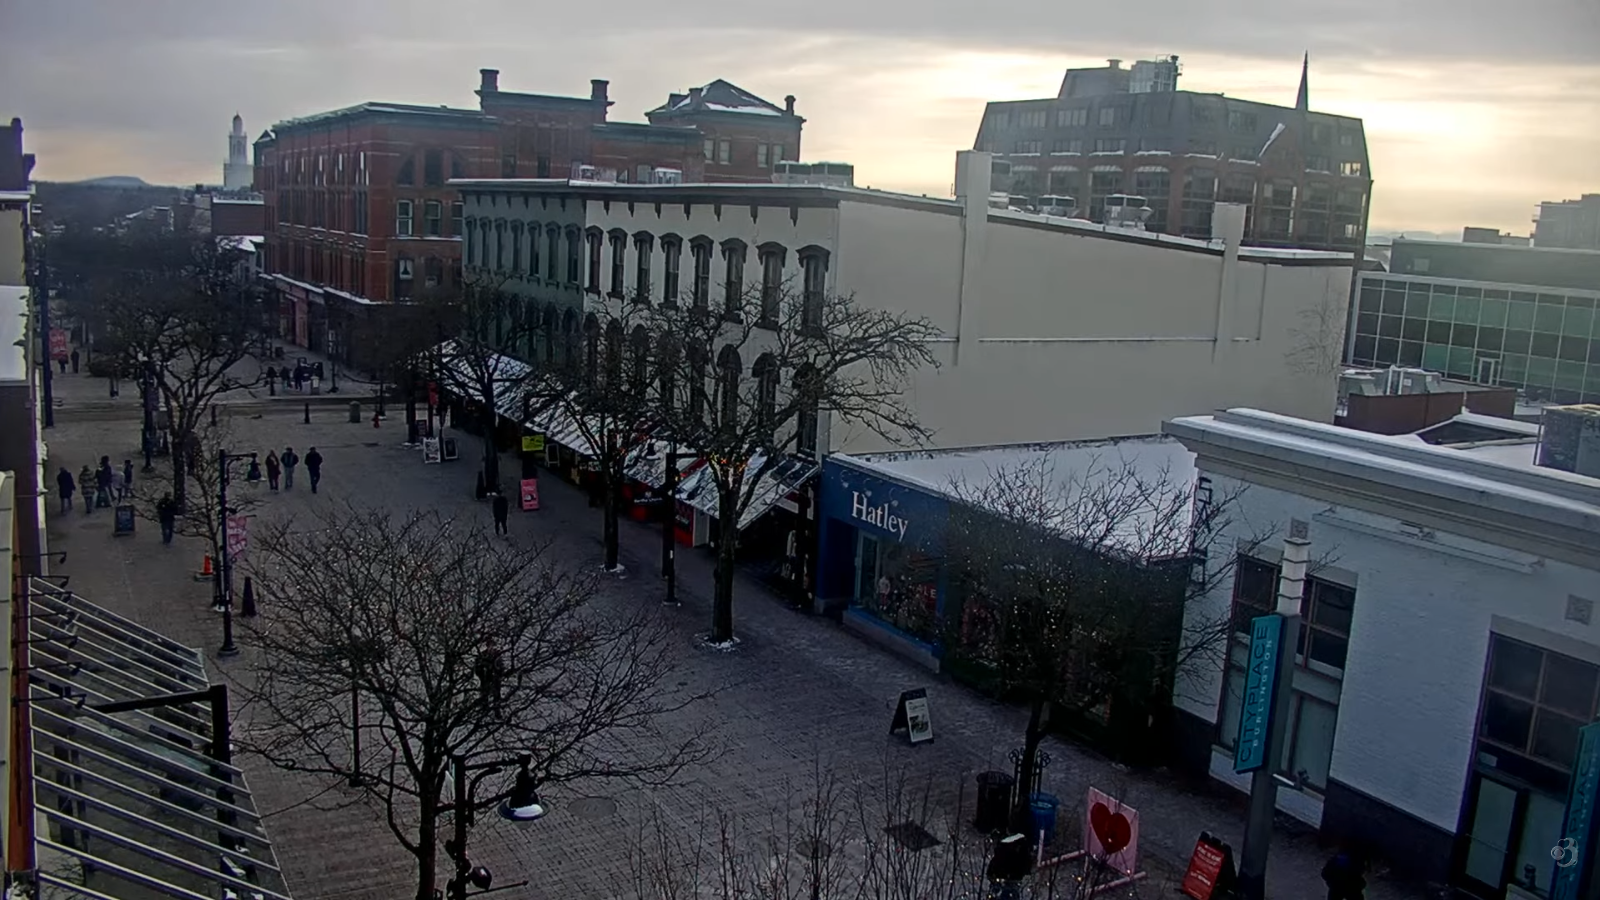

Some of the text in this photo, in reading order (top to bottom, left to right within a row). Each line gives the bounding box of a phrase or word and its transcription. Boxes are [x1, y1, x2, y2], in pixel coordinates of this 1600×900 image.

[851, 490, 909, 543] Hatley
[1240, 625, 1269, 763] CITYPLACE
[1252, 639, 1273, 747] BURLINGTON
